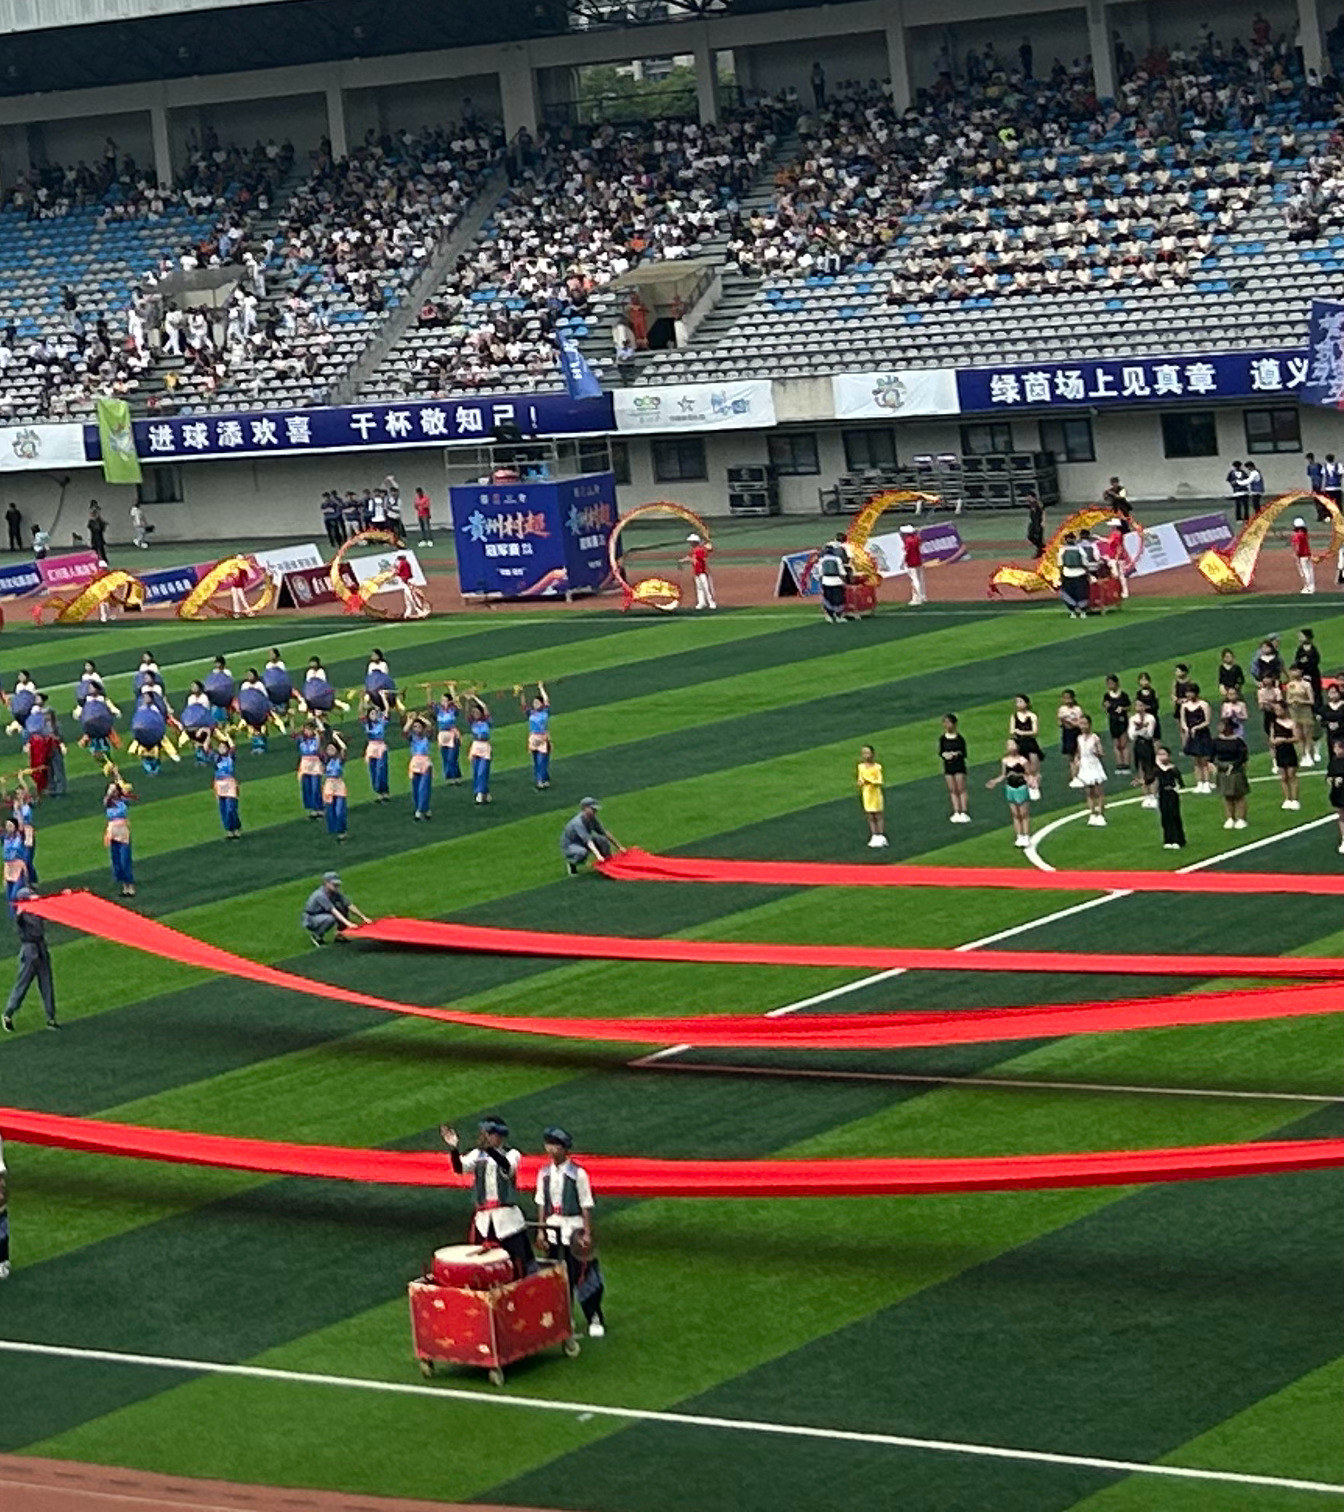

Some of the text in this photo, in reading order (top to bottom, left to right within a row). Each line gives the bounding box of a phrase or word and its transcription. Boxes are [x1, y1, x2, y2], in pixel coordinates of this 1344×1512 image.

[990, 362, 1217, 404] 绿茵场上见真章
[148, 416, 312, 452] 进球添欢喜
